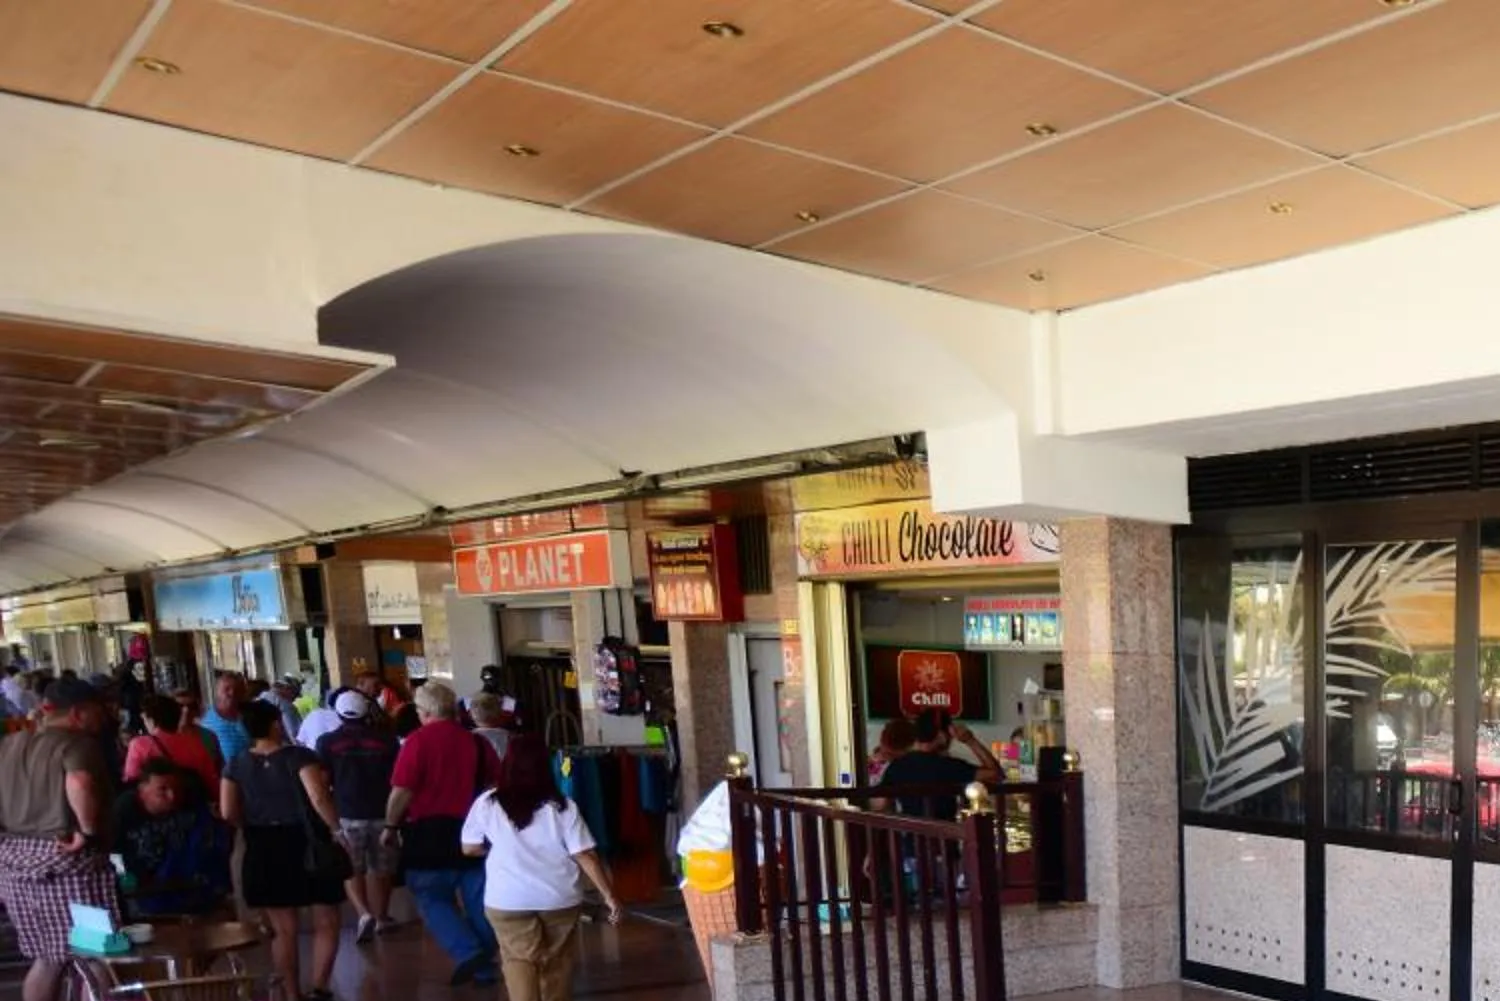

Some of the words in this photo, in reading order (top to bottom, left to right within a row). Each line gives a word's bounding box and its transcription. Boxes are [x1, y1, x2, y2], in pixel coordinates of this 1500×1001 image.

[841, 517, 891, 567] CHILLI
[899, 508, 1015, 562] Chocolate
[497, 541, 585, 588] PLANET
